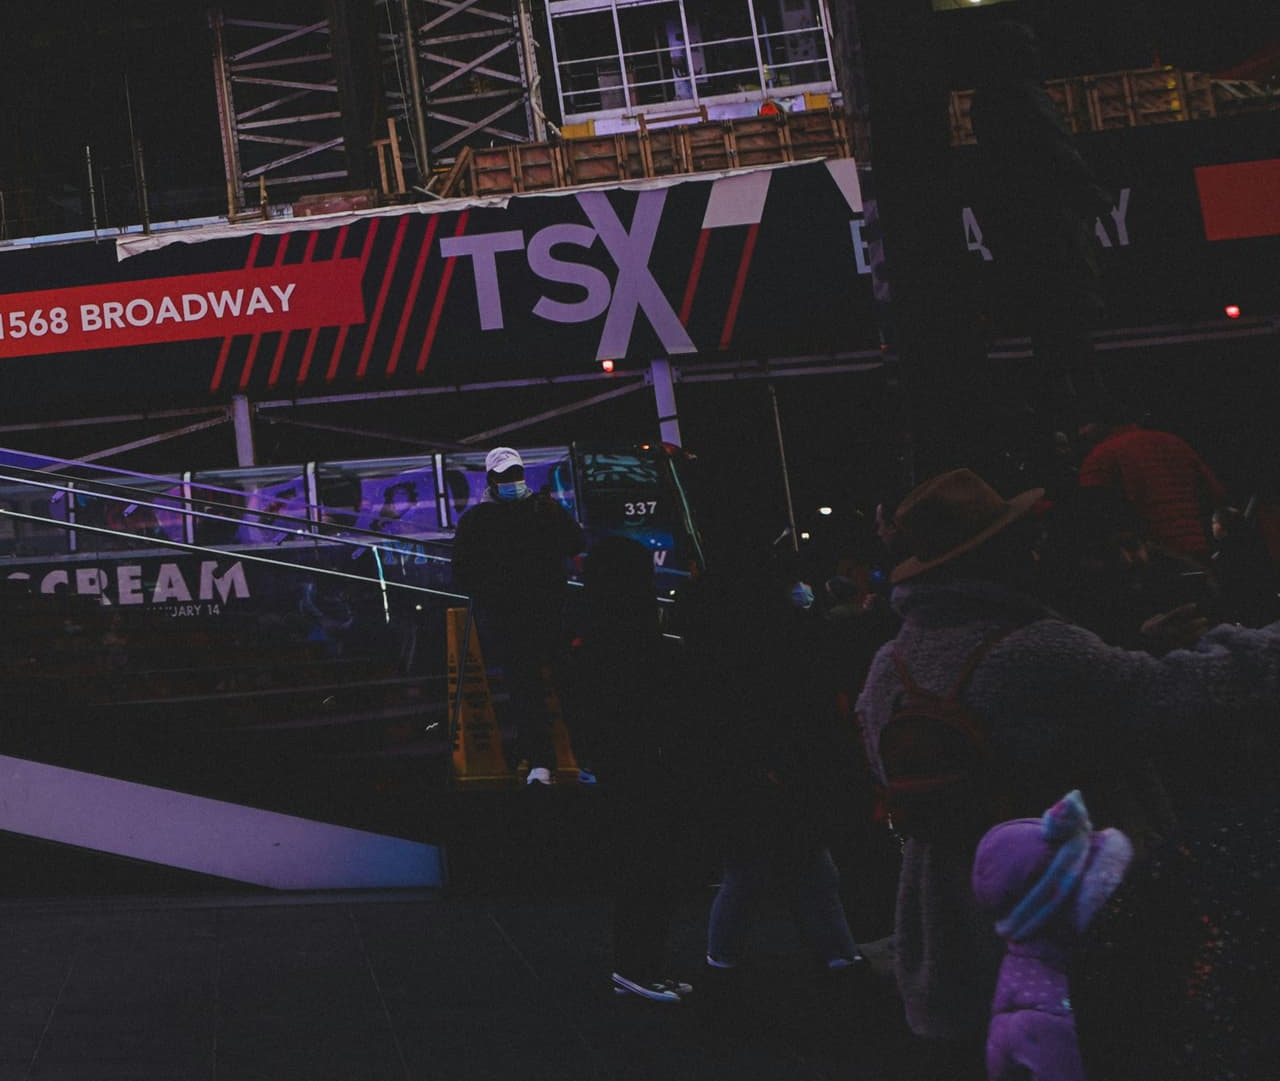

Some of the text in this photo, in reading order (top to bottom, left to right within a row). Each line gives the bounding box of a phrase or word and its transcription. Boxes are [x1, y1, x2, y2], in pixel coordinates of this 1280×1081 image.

[440, 188, 699, 361] TSX
[80, 283, 296, 333] BROADWAY
[624, 500, 658, 516] 337
[8, 560, 251, 605] CREAM
[208, 604, 221, 616] 14
